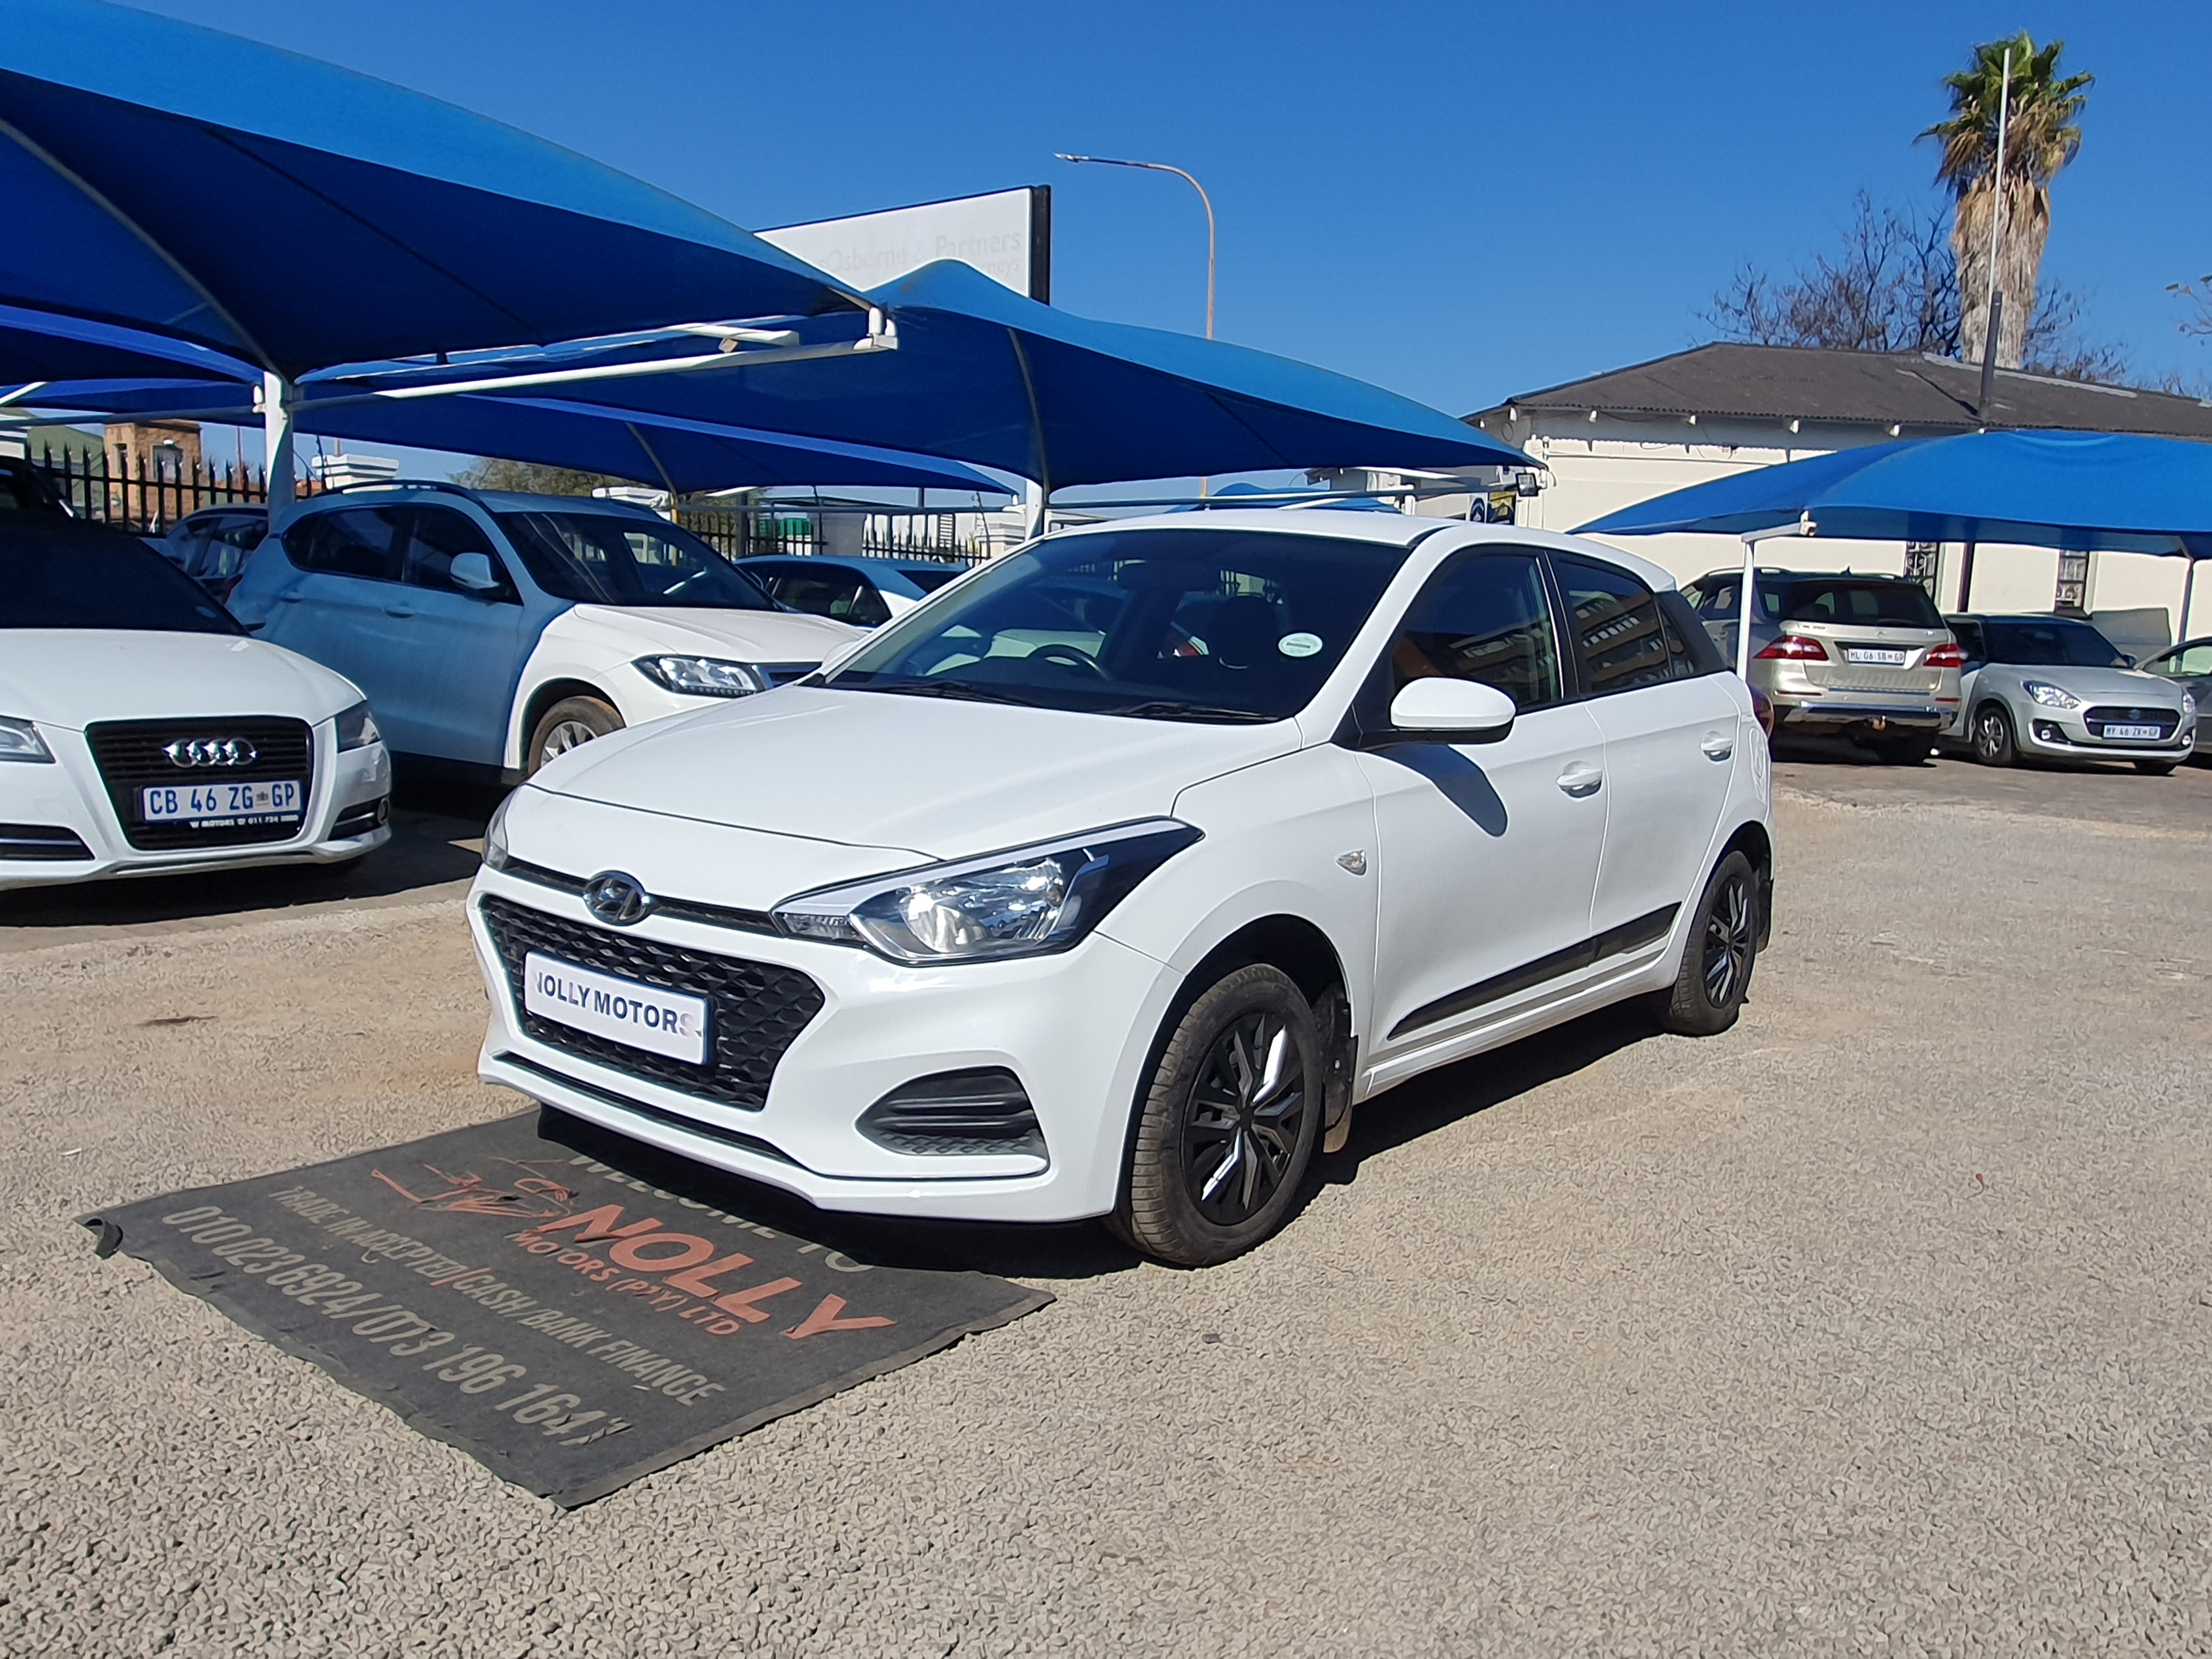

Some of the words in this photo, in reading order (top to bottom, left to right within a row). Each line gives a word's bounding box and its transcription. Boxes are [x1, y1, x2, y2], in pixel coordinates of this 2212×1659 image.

[150, 790, 178, 815] CB
[190, 788, 217, 812] 46
[228, 786, 254, 810] ZG
[272, 783, 295, 807] GP
[594, 990, 694, 1037] MOTORS
[537, 1204, 897, 1339] NOLLY
[678, 1305, 740, 1335] LTD
[422, 1344, 527, 1394] 196
[587, 1339, 726, 1406] FINANCE
